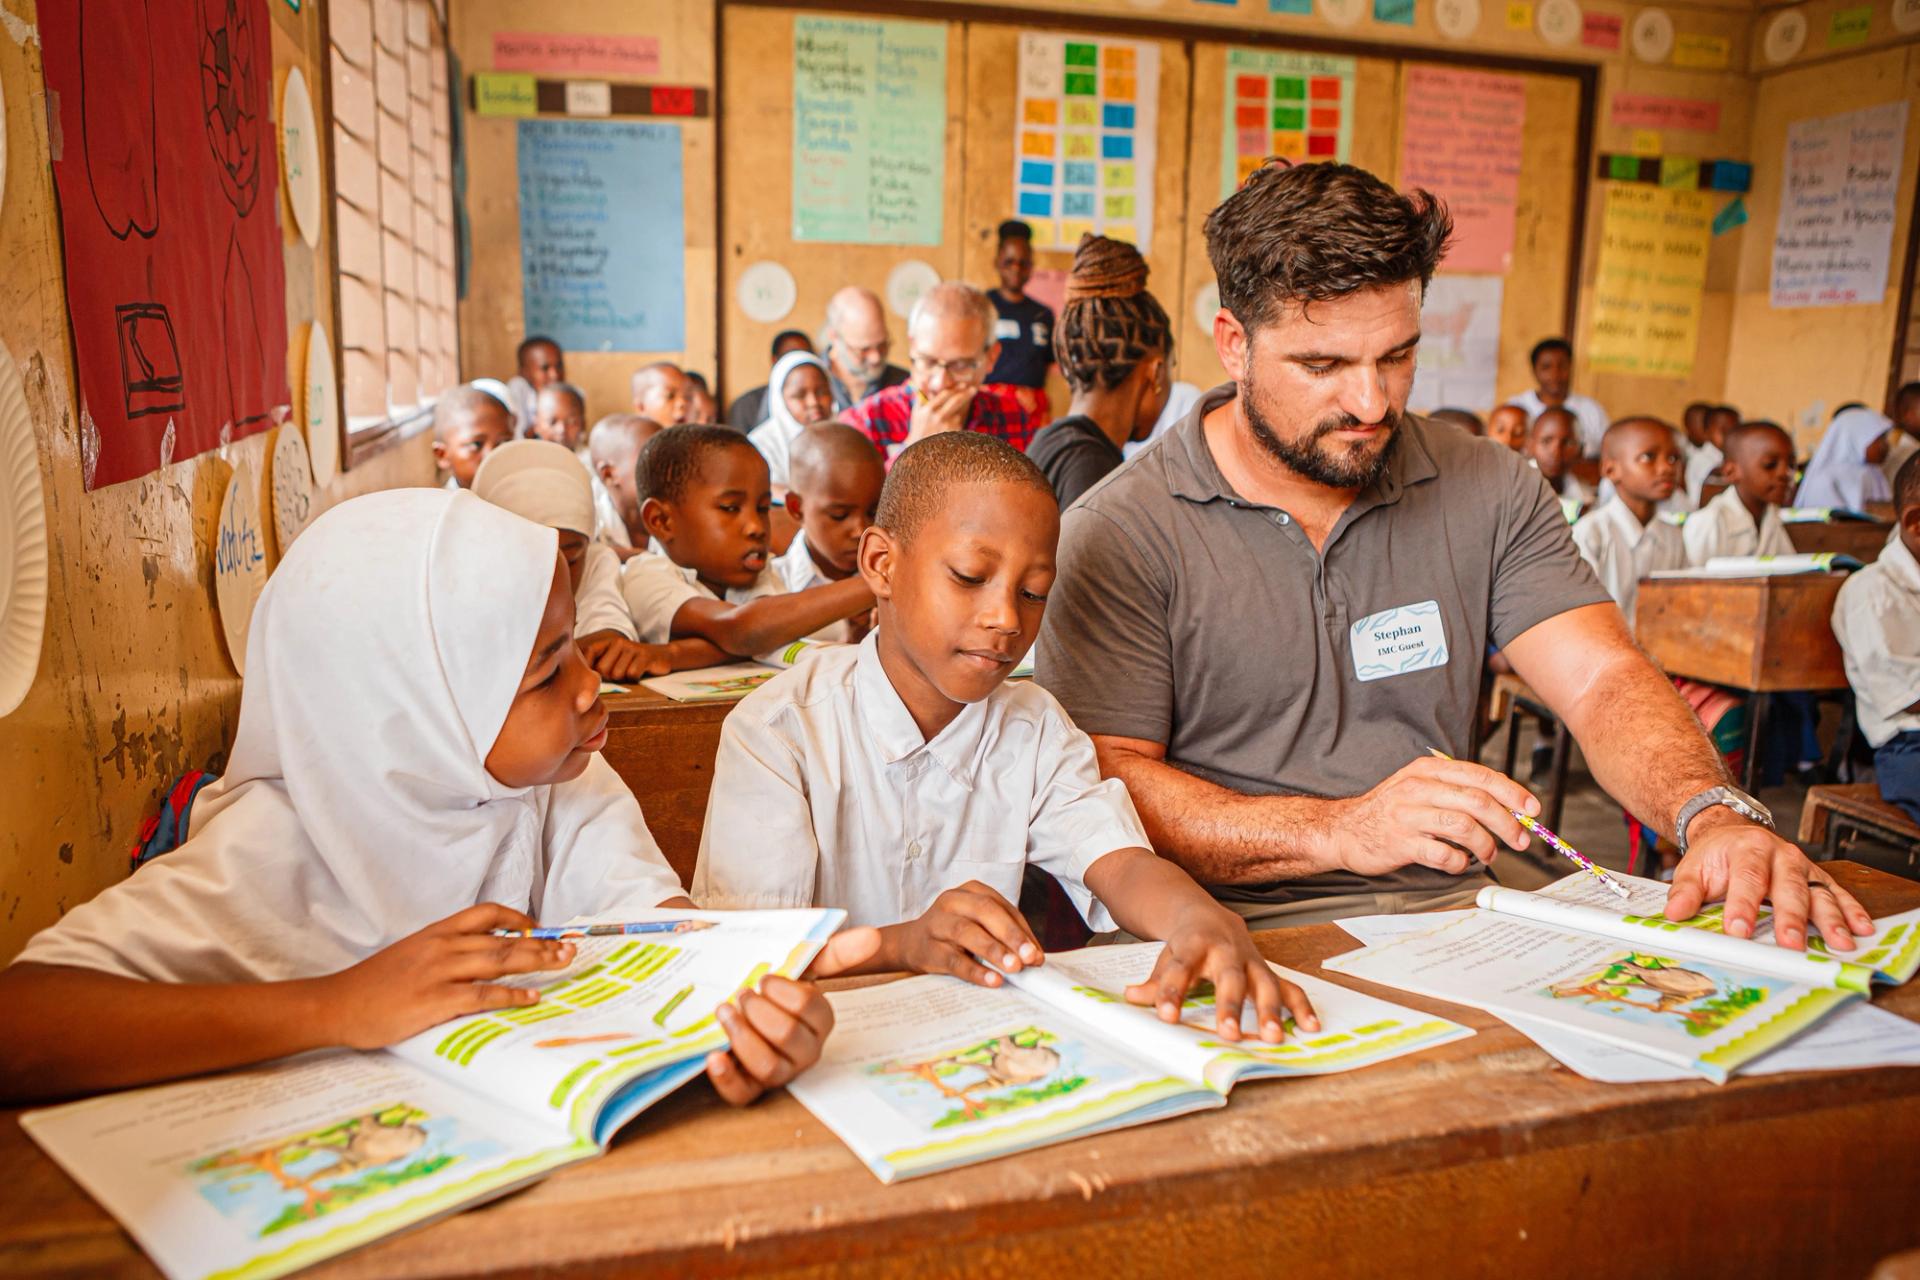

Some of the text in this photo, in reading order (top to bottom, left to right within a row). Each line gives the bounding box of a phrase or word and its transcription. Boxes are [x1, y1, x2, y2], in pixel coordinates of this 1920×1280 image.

[1374, 625, 1421, 640] Stephan
[1378, 640, 1424, 656] IMC Guest
